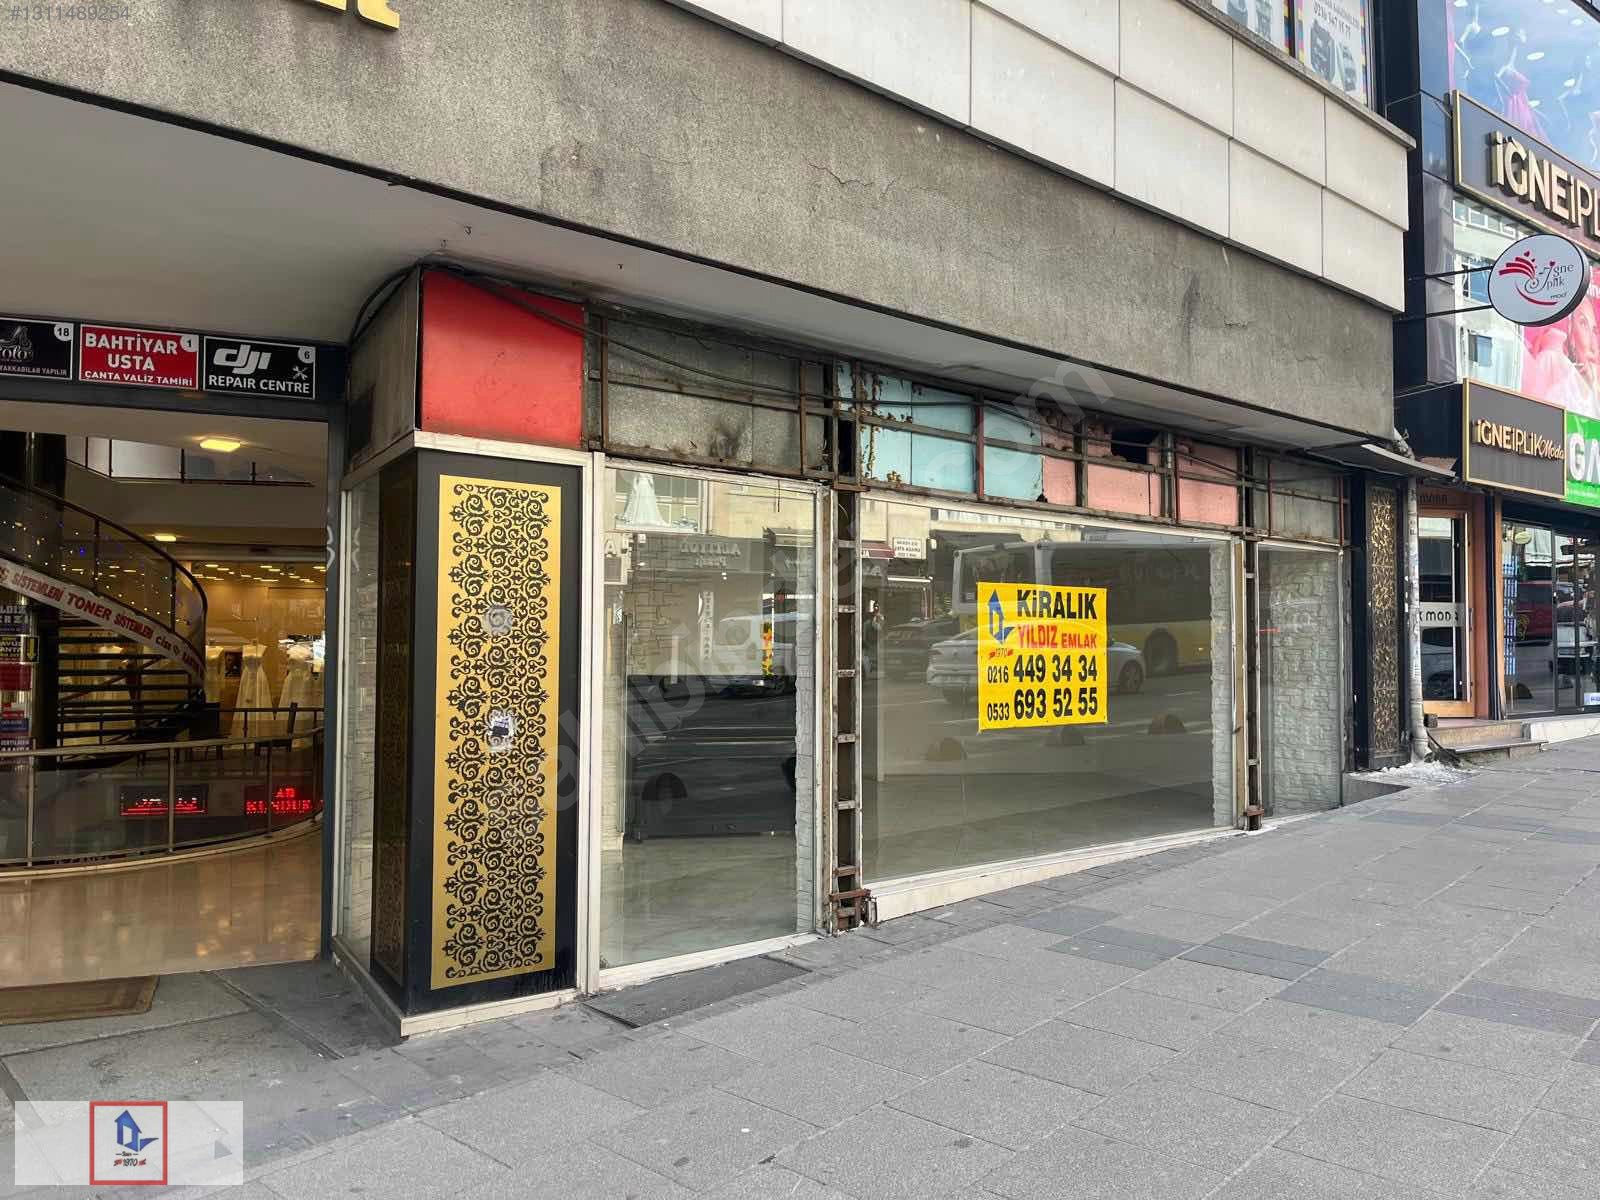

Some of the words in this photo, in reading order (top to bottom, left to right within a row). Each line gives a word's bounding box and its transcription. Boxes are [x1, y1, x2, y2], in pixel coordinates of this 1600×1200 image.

[57, 328, 70, 337] 18
[187, 339, 192, 348] 1
[107, 354, 155, 371] USTA
[304, 351, 310, 359] 6
[208, 374, 256, 389] REPAIR
[259, 379, 310, 394] CENTRE
[67, 592, 112, 621] TONER
[1017, 624, 1058, 649] YILDIZ
[1061, 632, 1097, 649] EMLAK
[987, 665, 1009, 684] 0216
[1013, 654, 1046, 683] 449
[1052, 654, 1073, 682] 34
[1078, 654, 1098, 682] 34
[987, 702, 1010, 721] 0533
[1014, 689, 1047, 720] 693
[1053, 688, 1073, 717] 52
[1078, 687, 1098, 715] 55
